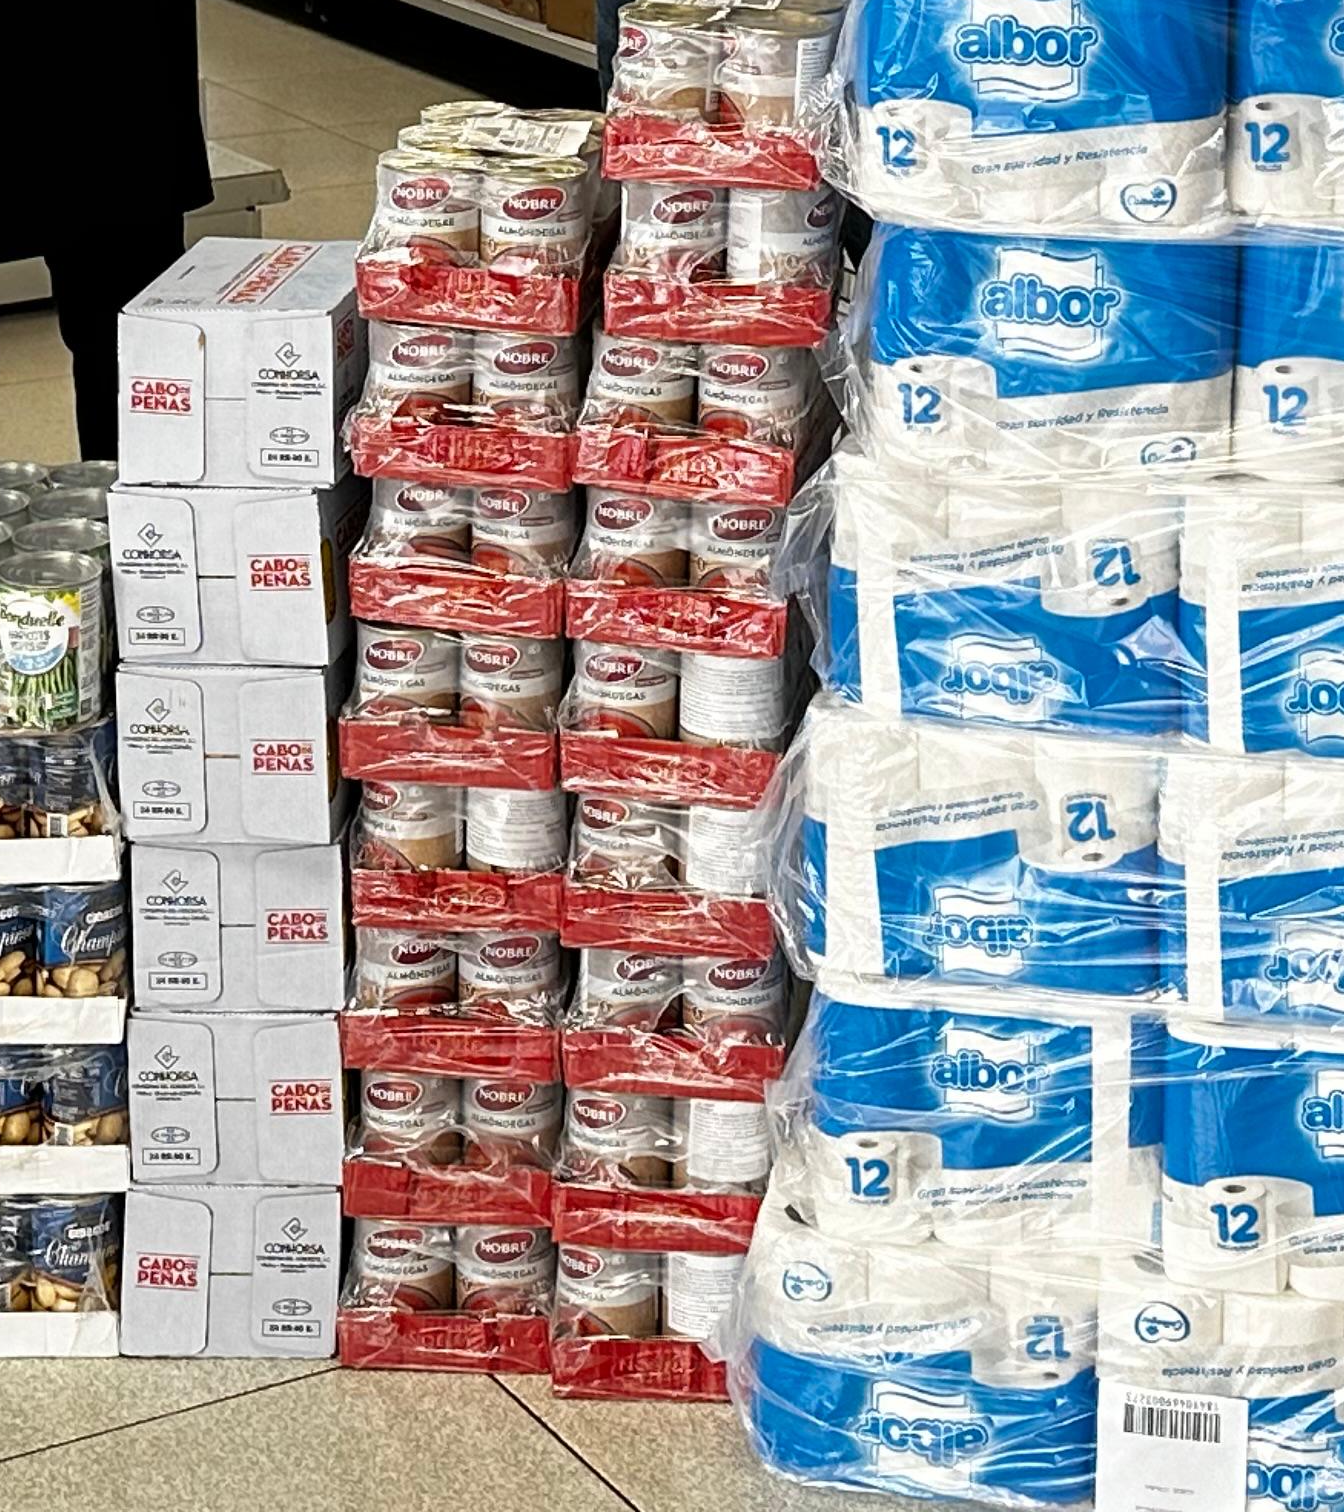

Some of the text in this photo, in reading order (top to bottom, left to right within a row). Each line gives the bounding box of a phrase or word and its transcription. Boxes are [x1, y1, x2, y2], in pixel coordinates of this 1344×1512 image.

[956, 15, 1097, 67] albor
[877, 126, 917, 167] 12
[1245, 123, 1290, 164] 12
[397, 186, 447, 201] NOBRE
[508, 197, 559, 212] NOBRE
[660, 201, 710, 216] NOBRE
[981, 276, 1120, 326] albor
[500, 352, 552, 366] NOBRE
[711, 362, 758, 376] NOBRE
[131, 380, 178, 396] CABO
[131, 394, 191, 412] PEÑAS
[897, 383, 943, 424] 12
[1263, 384, 1309, 426] 12
[716, 517, 767, 531] NOBRE
[250, 558, 296, 574] CABO
[1091, 541, 1141, 587] 12
[250, 571, 311, 589] PEÑAS
[369, 646, 415, 662] NOBRE
[941, 659, 1057, 701] albor
[253, 743, 300, 757] CABO
[253, 755, 314, 773] PEÑAS
[1066, 798, 1116, 842] 12
[267, 912, 314, 926] CABO
[267, 924, 328, 942] PEÑAS
[924, 914, 1034, 953] albor
[931, 1050, 1049, 1094] albor
[271, 1082, 317, 1096] CABO
[271, 1094, 332, 1112] PEÑAS
[845, 1156, 890, 1197] 12
[1212, 1203, 1260, 1245] 12
[138, 1256, 184, 1271] CABO
[138, 1268, 198, 1287] PEÑAS
[1025, 1324, 1071, 1361] 12
